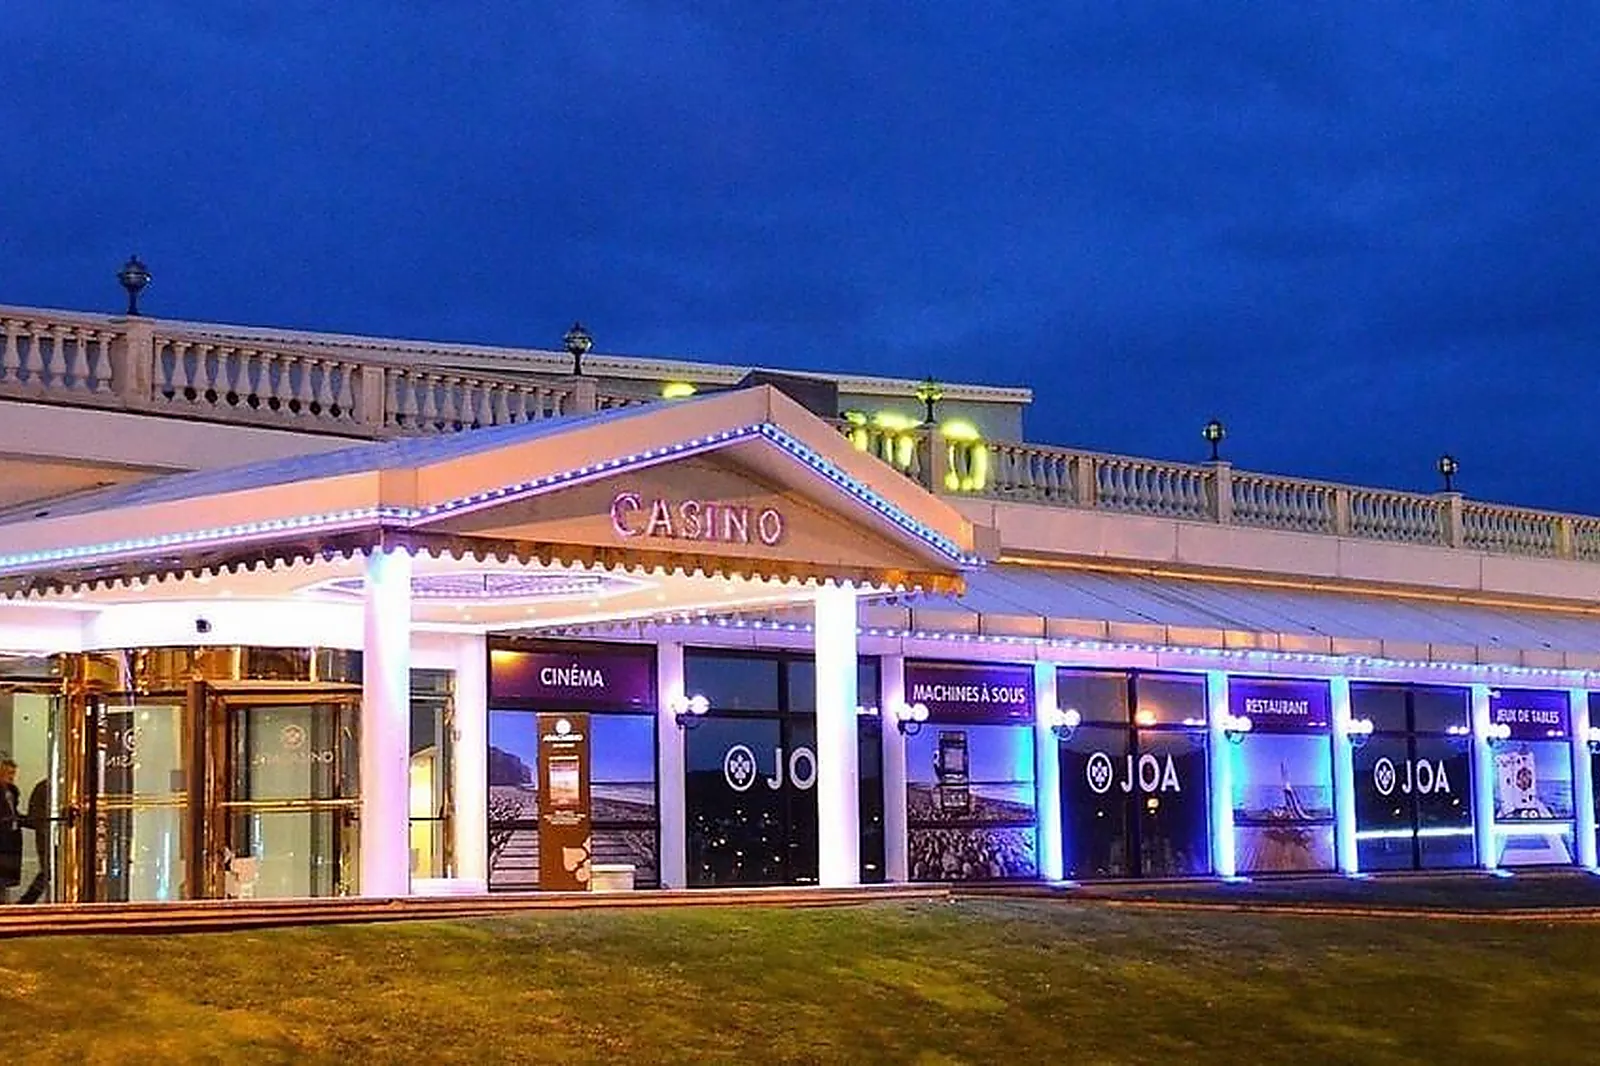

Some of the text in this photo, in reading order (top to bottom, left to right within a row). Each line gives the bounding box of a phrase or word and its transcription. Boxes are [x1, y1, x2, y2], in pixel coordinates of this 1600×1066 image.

[611, 491, 784, 546] CASINO
[540, 663, 605, 688] CINÉMA
[913, 682, 1026, 704] MACHINES À SOUS
[1245, 698, 1309, 715] RESTAURANT
[1517, 709, 1531, 723] DE
[767, 746, 818, 792] JO
[1120, 753, 1181, 794] JOA
[1401, 759, 1452, 795] JOA
